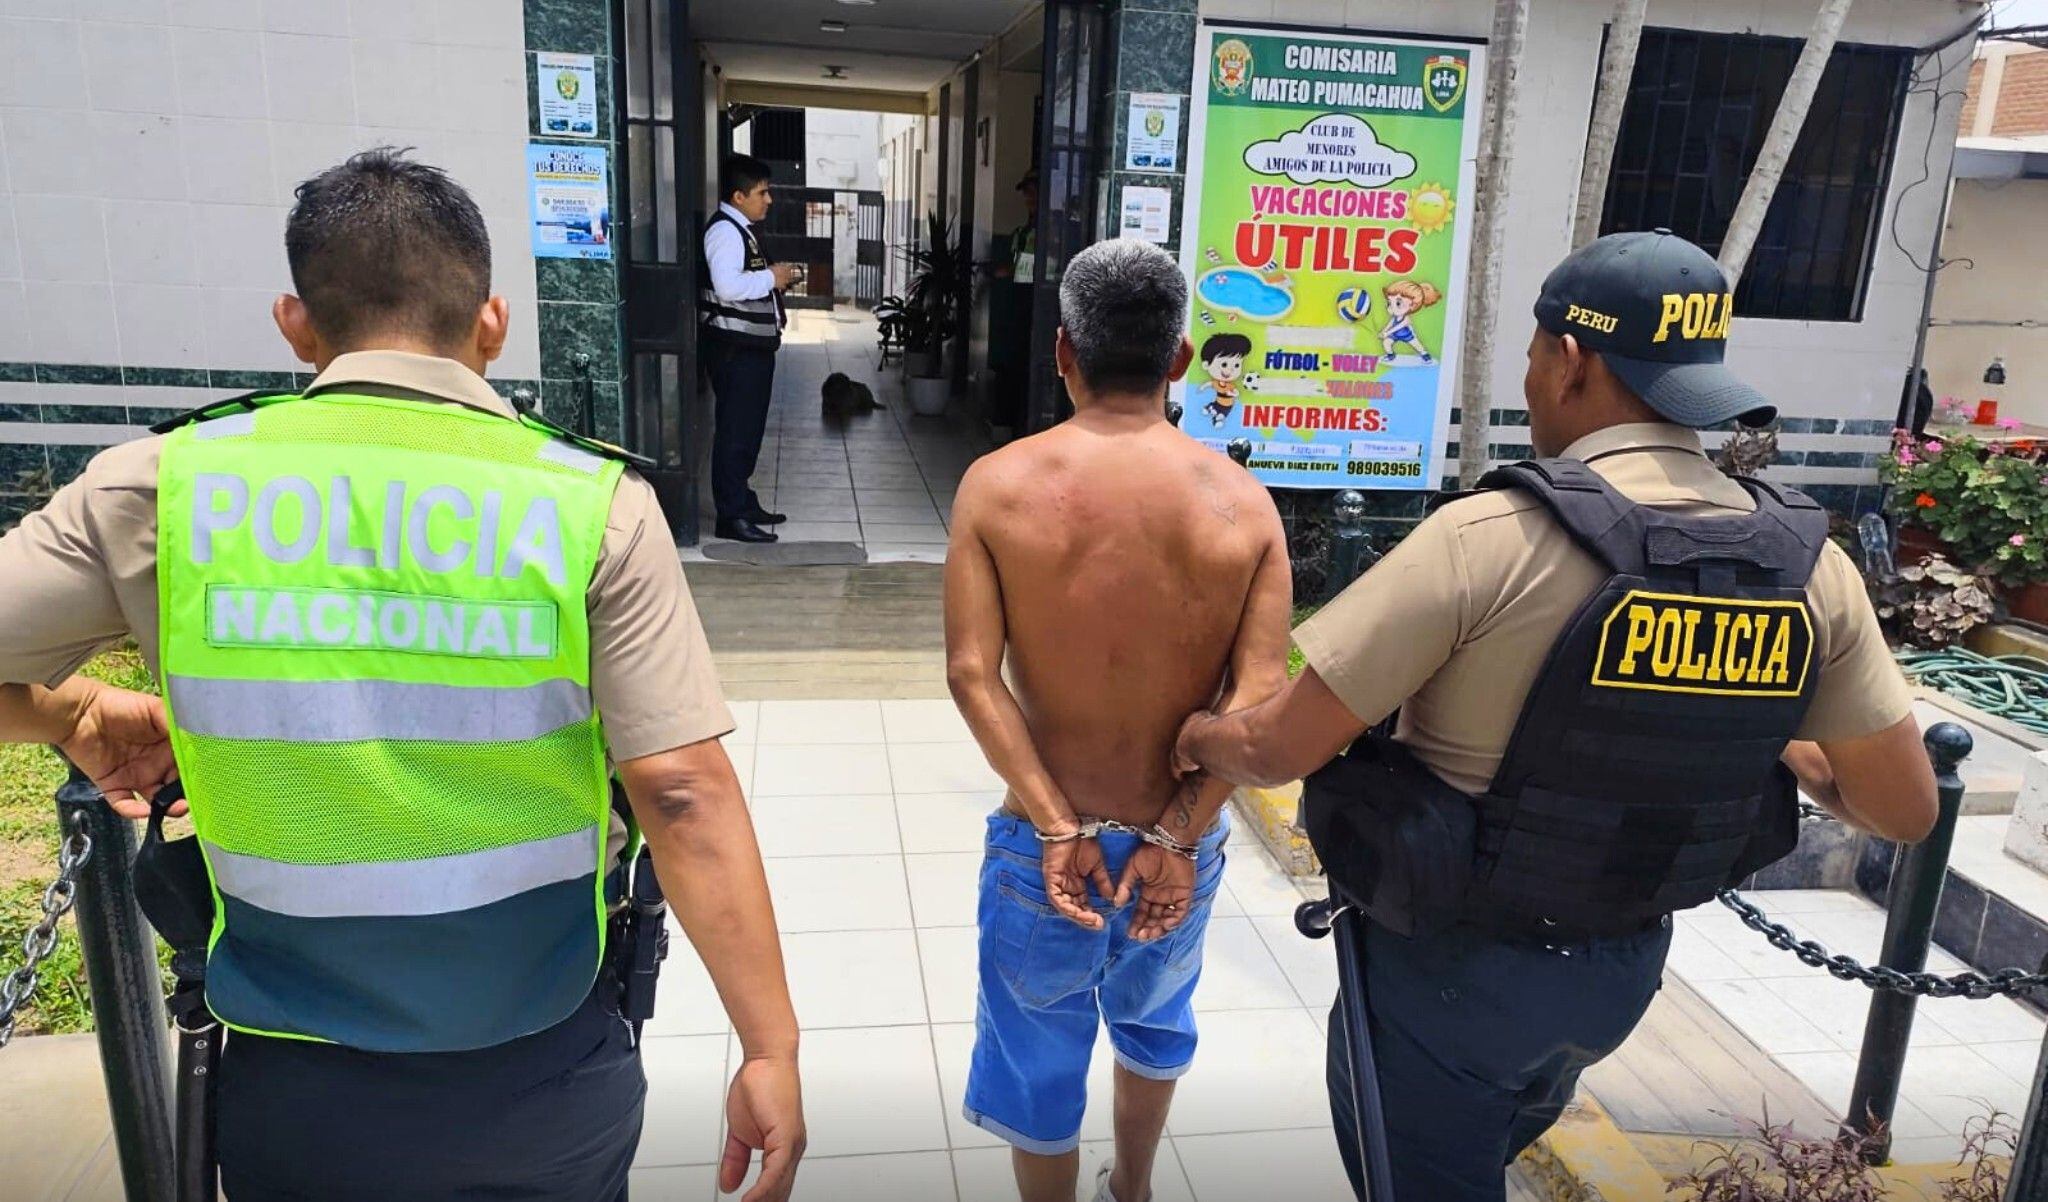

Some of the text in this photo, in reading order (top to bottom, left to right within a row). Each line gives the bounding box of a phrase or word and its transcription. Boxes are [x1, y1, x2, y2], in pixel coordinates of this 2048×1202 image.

[1285, 45, 1397, 75] COMISARIA
[1251, 77, 1424, 110] MATEO PUMACAHUA
[1310, 124, 1355, 138] CLUB DE
[1307, 143, 1357, 157] MENORES
[1264, 157, 1392, 177] AMIGOS DE LA POLICIA
[1251, 185, 1408, 219] VACACIONES
[1235, 213, 1420, 274] ÚTILES
[1566, 305, 1618, 333] PERU
[1265, 349, 1320, 371] FÚTBOL
[1332, 354, 1379, 373] VOLEY
[1325, 380, 1393, 399] VALORES
[1242, 405, 1388, 432] INFORMES:
[1347, 461, 1421, 476] 989039516
[190, 472, 568, 586] POLICIA
[214, 590, 549, 657] NACIONAL
[1618, 604, 1790, 684] POLICIA
